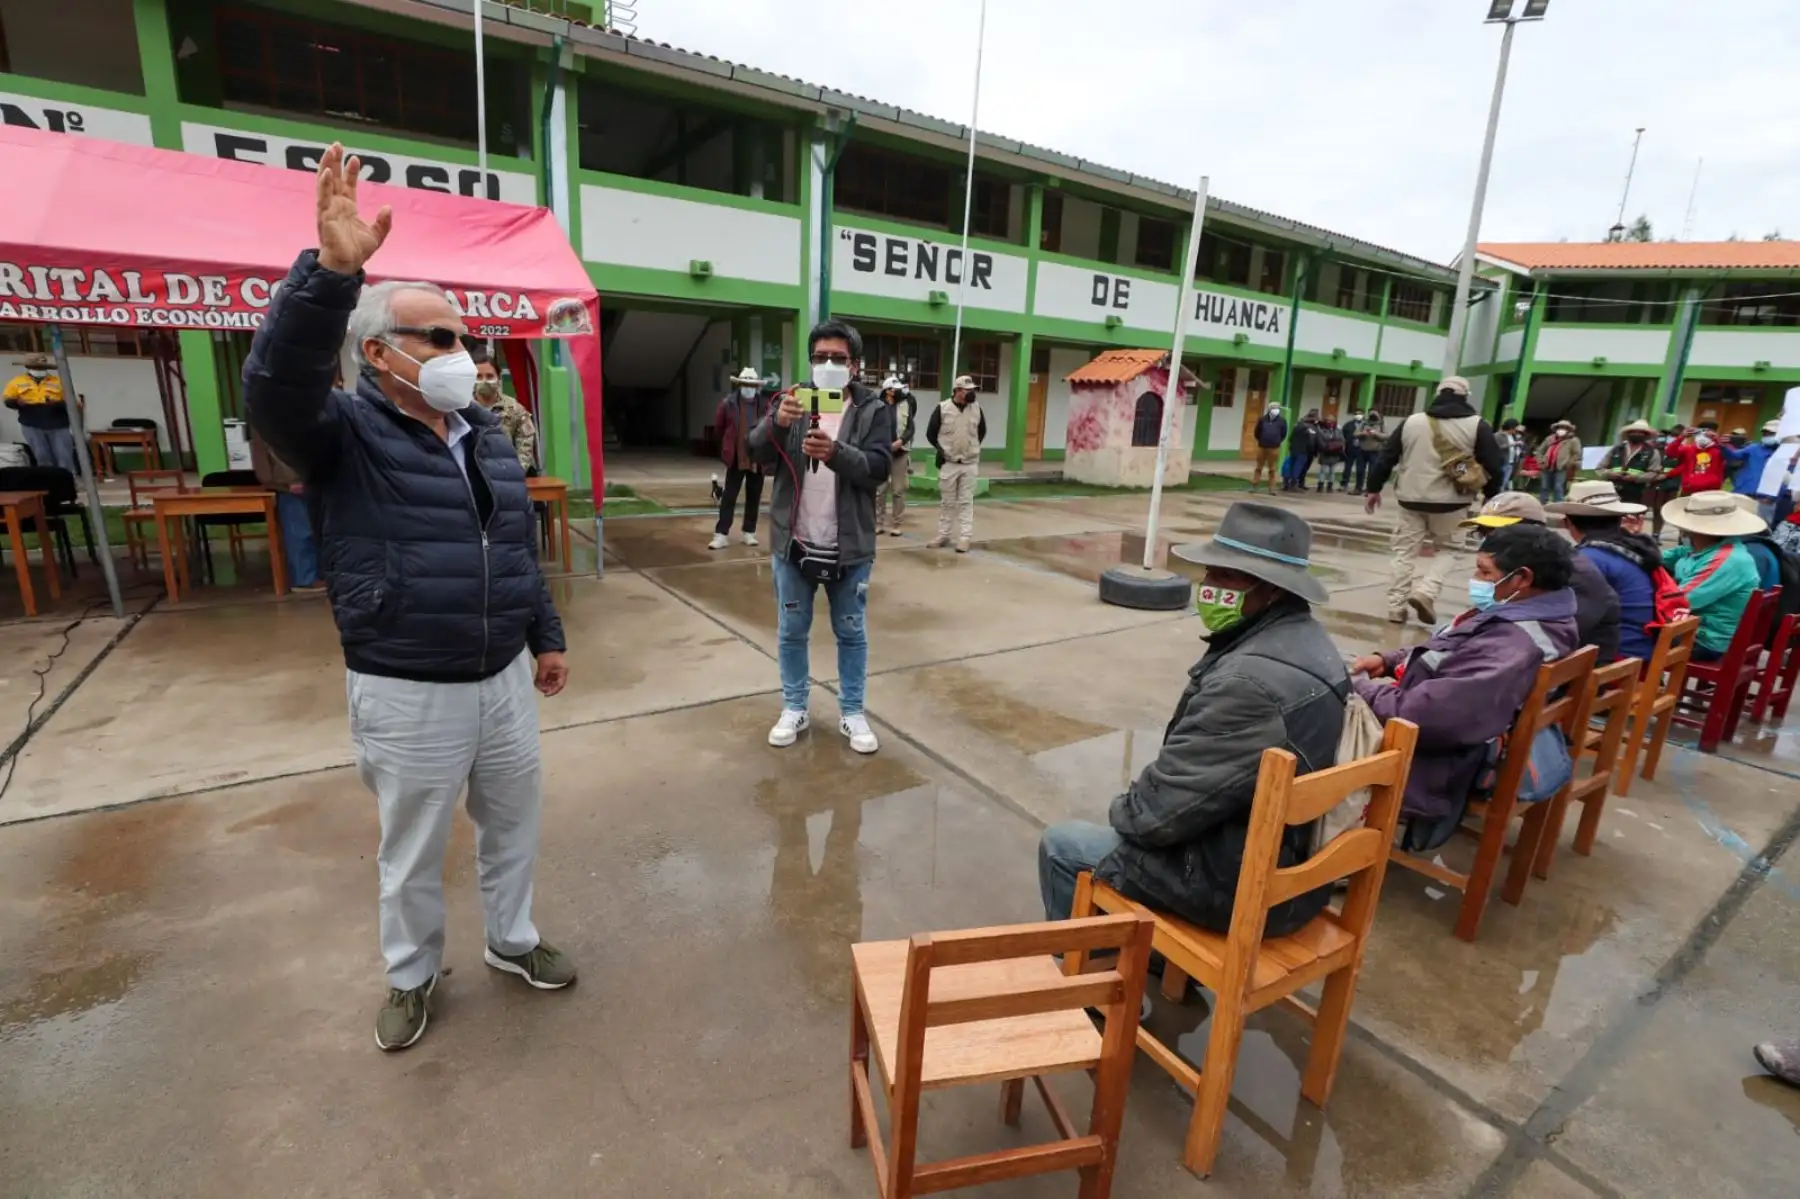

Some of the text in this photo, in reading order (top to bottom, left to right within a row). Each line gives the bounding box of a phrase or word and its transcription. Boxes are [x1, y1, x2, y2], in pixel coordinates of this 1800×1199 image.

[0, 262, 155, 303] RITAL
[163, 273, 231, 307] DE
[1091, 274, 1130, 309] DE
[0, 301, 130, 323] ARROLLO
[479, 325, 511, 336] 2022
